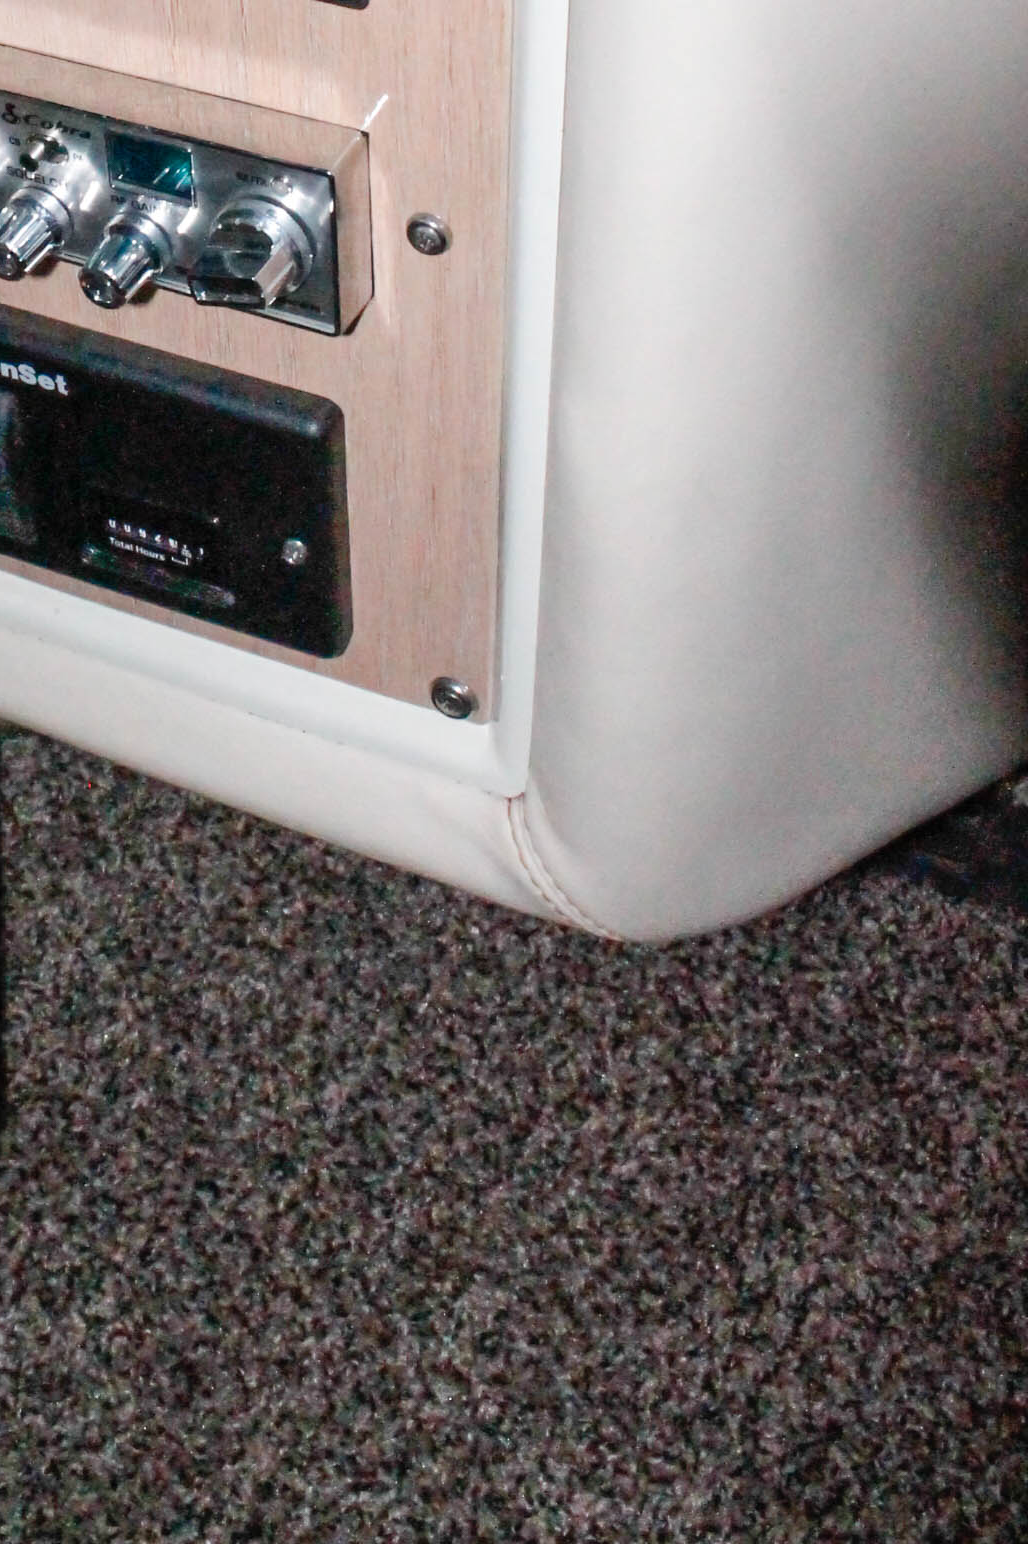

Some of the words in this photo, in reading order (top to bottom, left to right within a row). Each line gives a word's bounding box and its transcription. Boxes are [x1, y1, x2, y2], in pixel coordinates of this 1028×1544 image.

[23, 113, 92, 139] Cobra
[109, 536, 134, 552] Total
[135, 544, 166, 562] Hours
